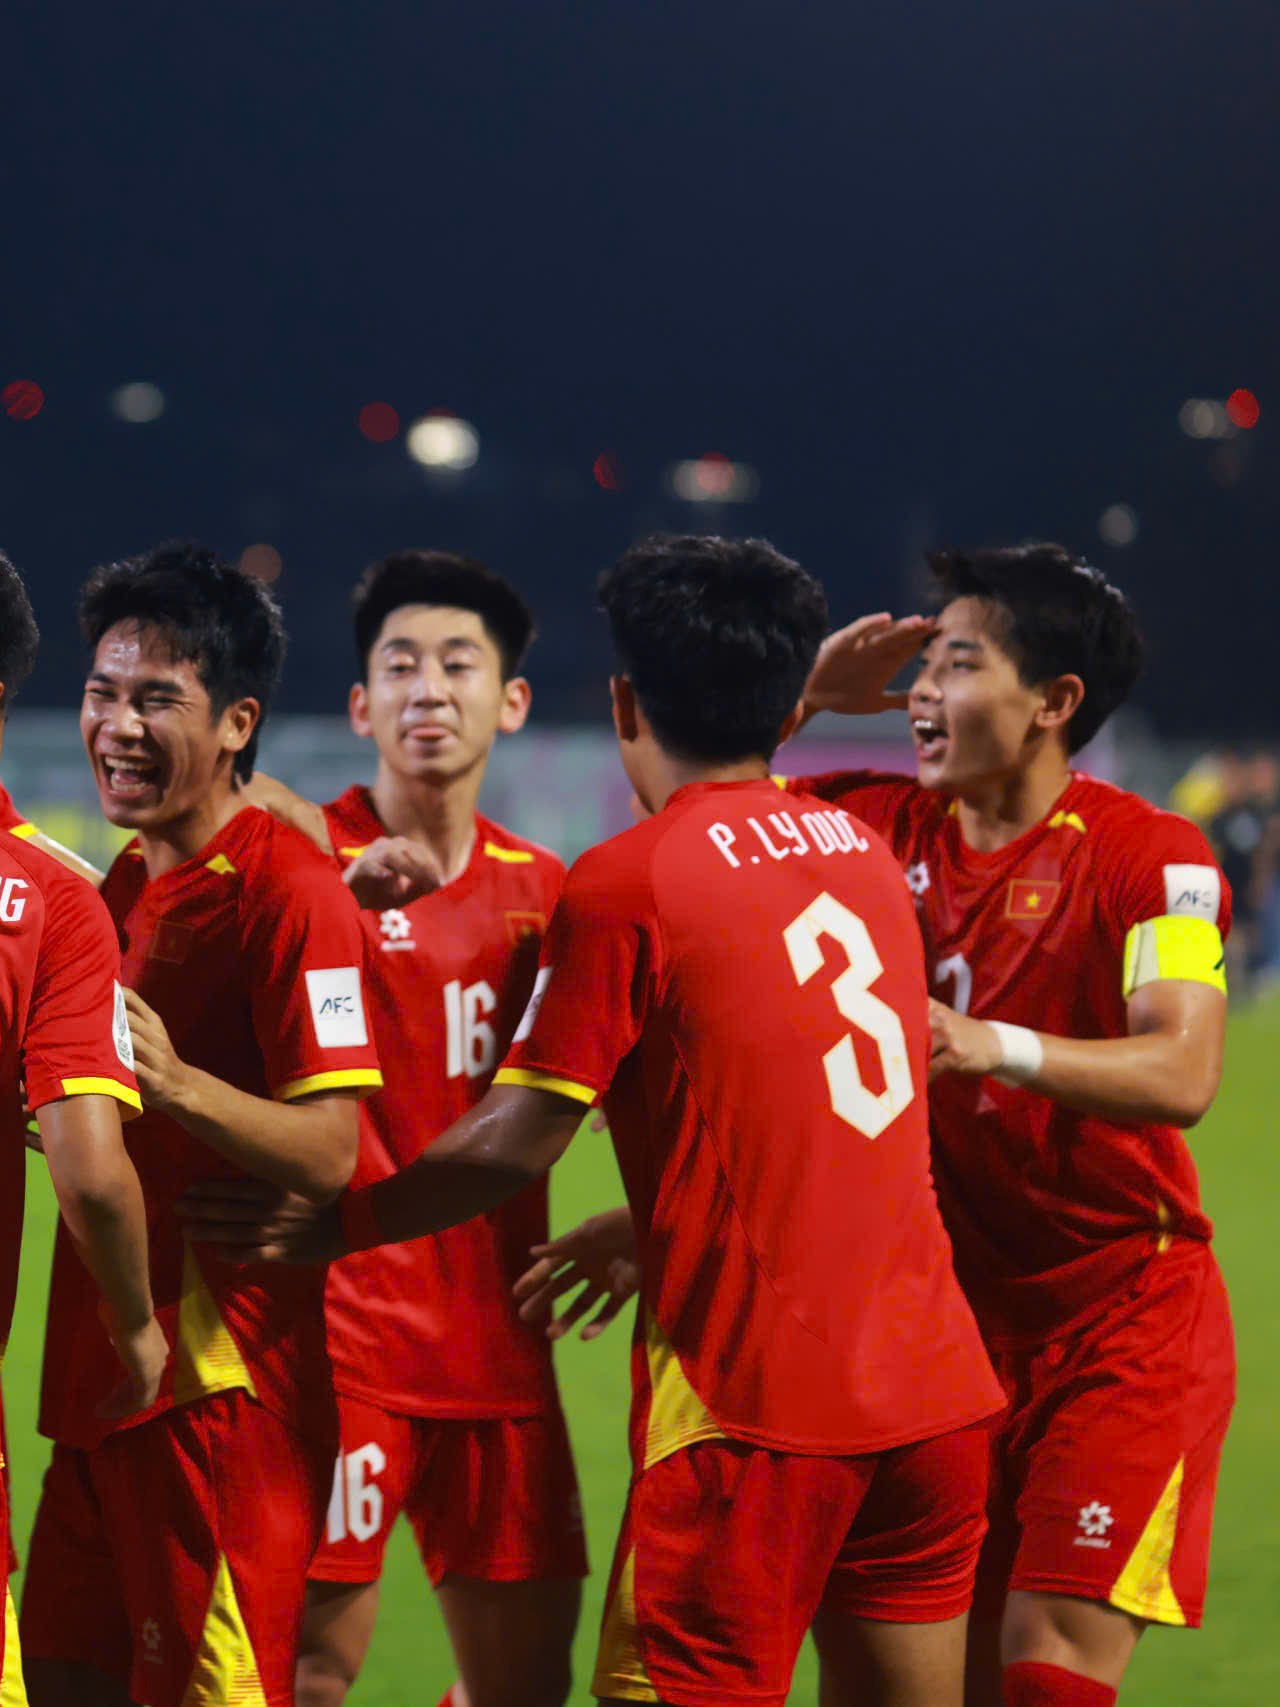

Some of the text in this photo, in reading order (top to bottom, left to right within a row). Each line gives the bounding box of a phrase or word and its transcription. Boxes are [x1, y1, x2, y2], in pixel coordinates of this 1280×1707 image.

[319, 997, 354, 1015] AFC
[443, 979, 497, 1079] 16
[783, 891, 915, 1140] 3
[327, 1442, 386, 1543] 16
